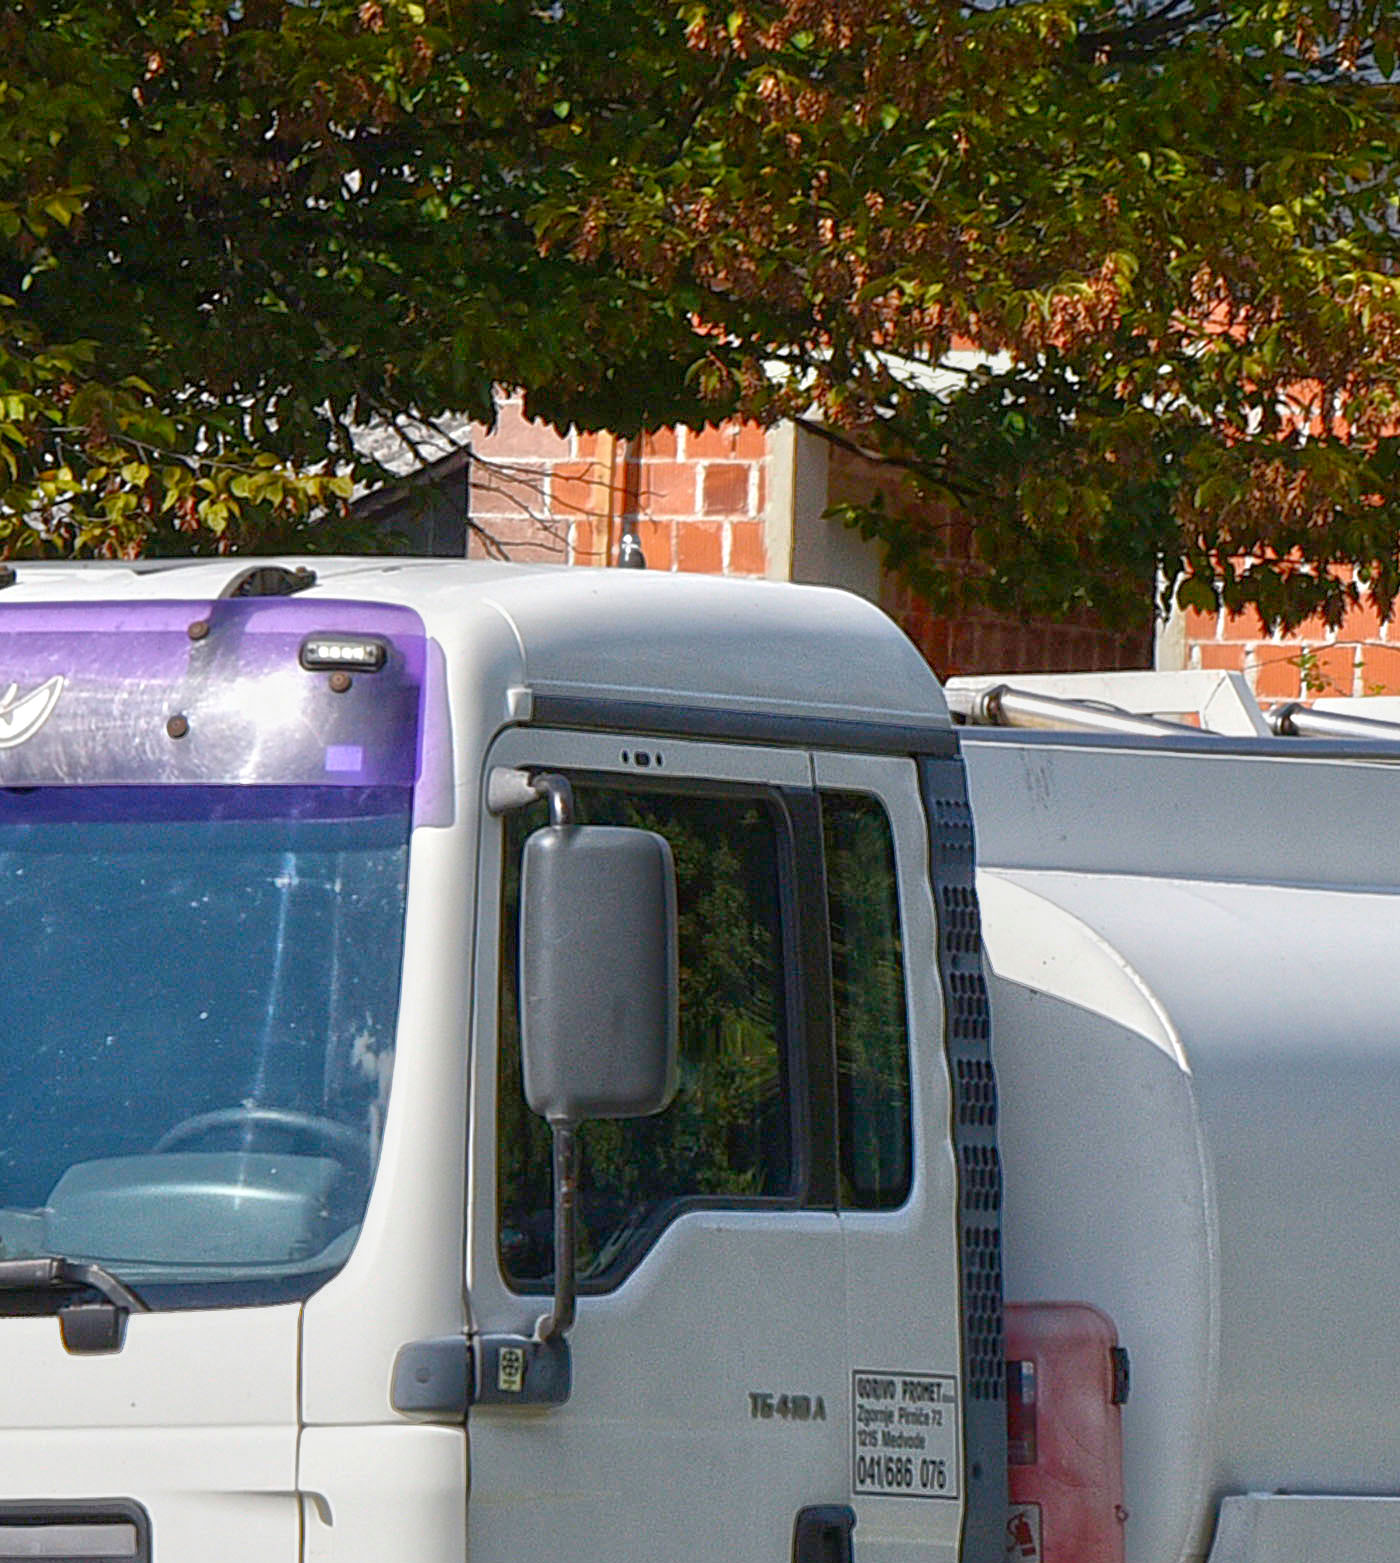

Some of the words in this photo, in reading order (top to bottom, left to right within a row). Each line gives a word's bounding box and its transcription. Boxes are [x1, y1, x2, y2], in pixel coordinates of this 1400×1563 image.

[857, 1430, 878, 1448] 1215
[881, 1430, 926, 1450] Medvode
[919, 1457, 947, 1490] 076
